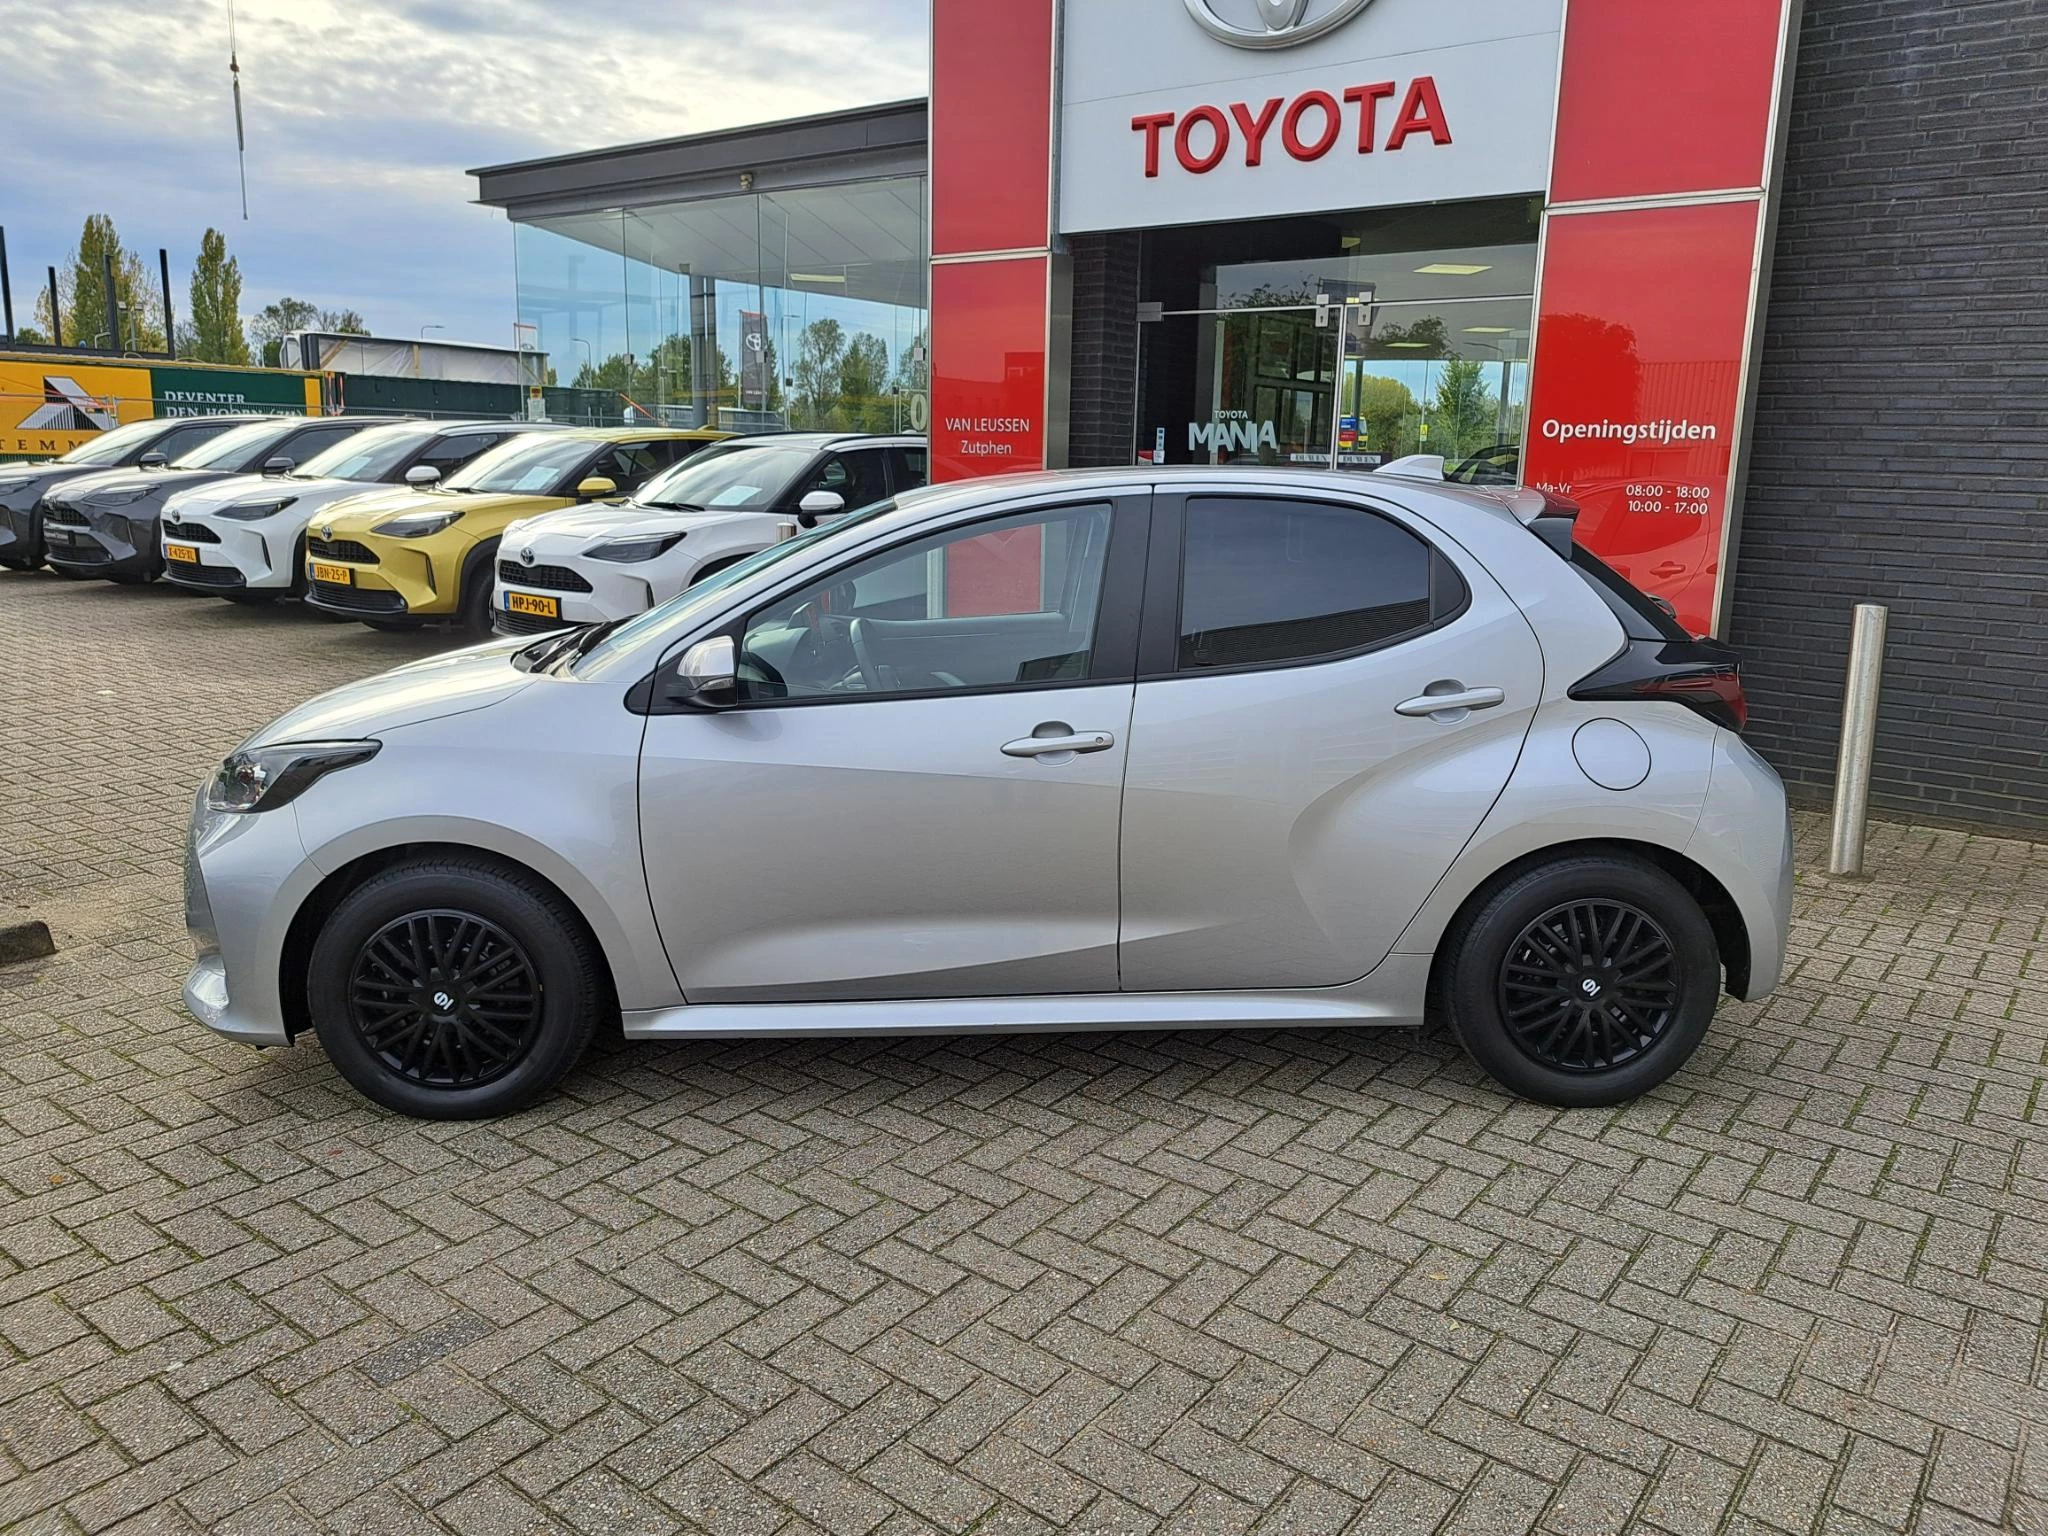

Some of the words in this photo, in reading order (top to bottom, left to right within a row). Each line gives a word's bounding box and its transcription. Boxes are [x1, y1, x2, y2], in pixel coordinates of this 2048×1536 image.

[1131, 75, 1453, 178] TOYOTA
[164, 391, 246, 404] DEVENTER
[166, 406, 199, 417] DEN
[1214, 410, 1249, 419] TOYOTA
[945, 417, 971, 432] VAN
[974, 418, 1030, 432] LEUSSEN
[1542, 419, 1716, 444] Openingstijden
[1188, 420, 1277, 453] MANIA
[961, 440, 1012, 456] Zutphen
[1625, 484, 1664, 497] 08:00
[1676, 486, 1710, 499] 18:00
[1628, 500, 1662, 513] 10:00
[1674, 502, 1708, 515] 17:00
[316, 566, 347, 581] JBN-25-P
[512, 595, 554, 615] HPJ-90-L
